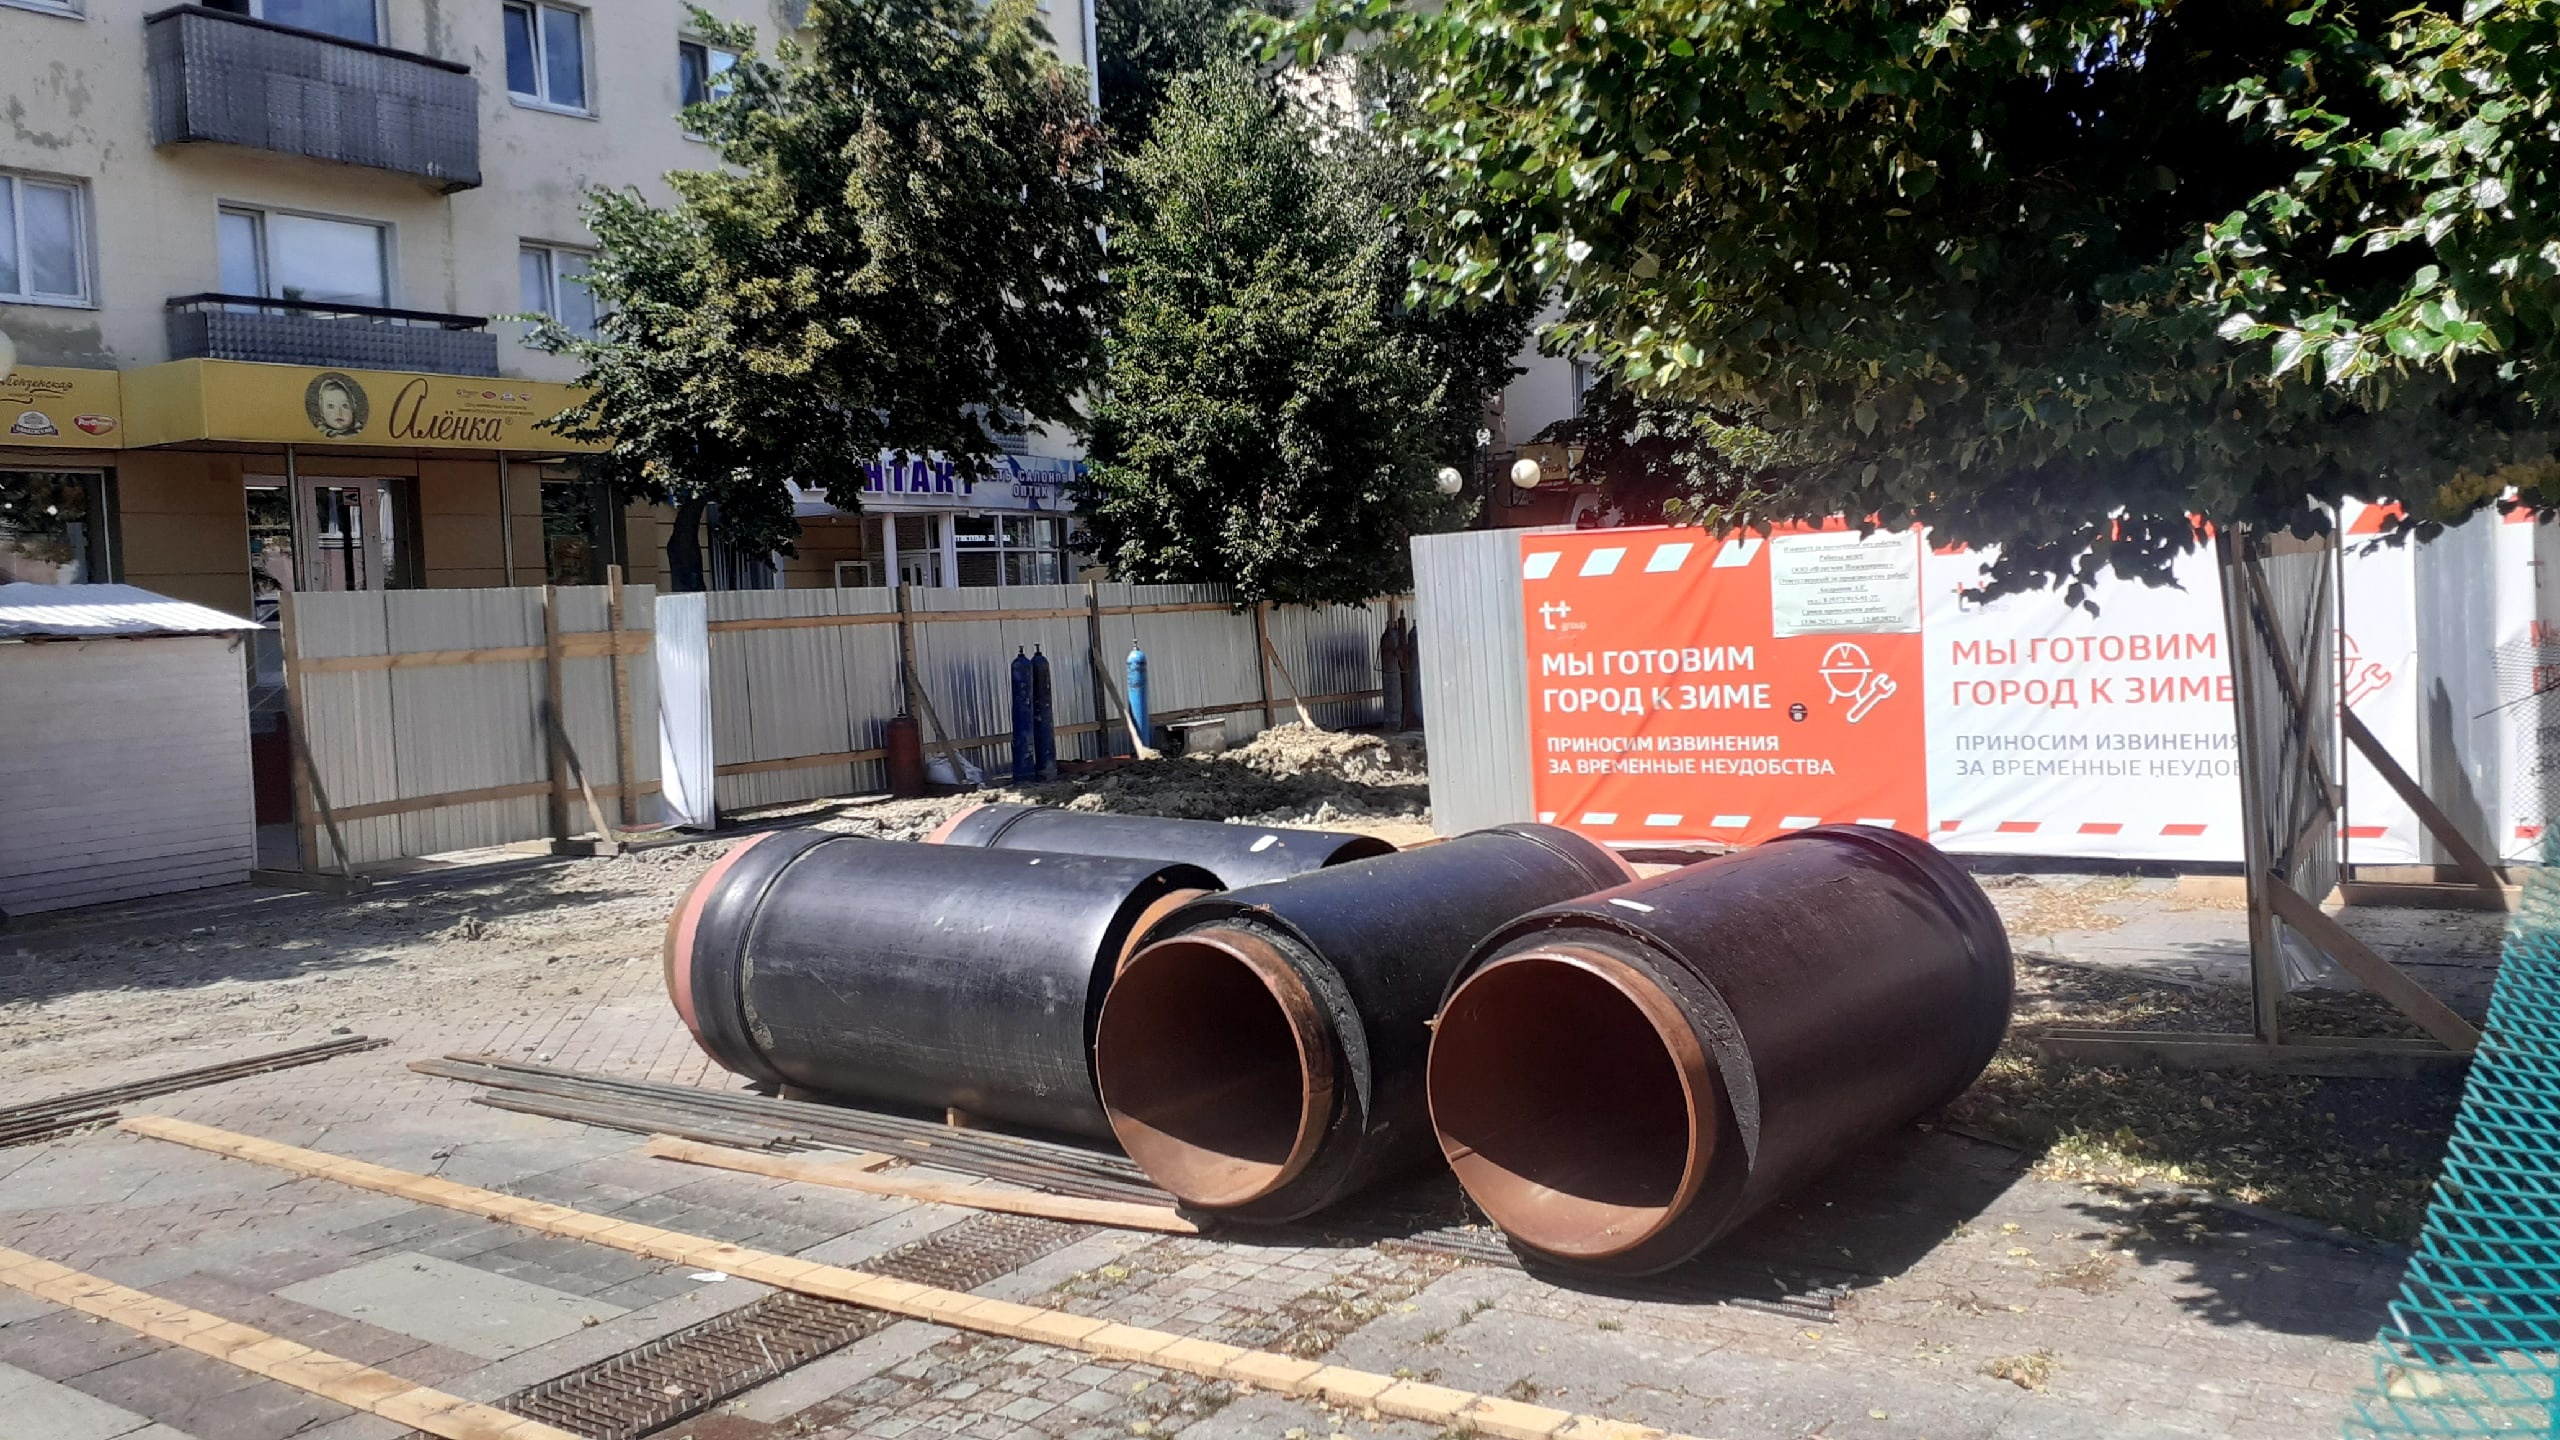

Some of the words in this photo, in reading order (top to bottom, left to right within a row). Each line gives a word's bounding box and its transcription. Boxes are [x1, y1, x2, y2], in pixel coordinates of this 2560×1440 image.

[389, 378, 503, 442] Алёнка
[1012, 485, 1049, 498] ОПТИК
[1561, 621, 1587, 632] group
[1952, 638, 2016, 665] МЫ
[2030, 633, 2217, 663] ГОТОВИМ
[1542, 651, 1595, 677] МЫ
[1602, 646, 1755, 675] ГОТОВИМ
[1543, 687, 1645, 715] ГОРОД
[1652, 687, 1673, 710] К
[1679, 683, 1772, 710] ЗИМЕ
[1952, 679, 2079, 709] ГОРОД
[2091, 678, 2114, 704] К
[2125, 675, 2236, 703] ЗИМЕ
[1547, 736, 1653, 753] ПРИНОСИМ
[1657, 735, 1780, 751] ИЗВИНЕНИЯ
[1955, 734, 2088, 751] ПРИНОСИМ
[1548, 758, 1573, 774] ЗА
[1577, 758, 1697, 775] ВРЕМЕННЫЕ
[1701, 758, 1836, 776] НЕУДОБСТВА
[1955, 759, 1985, 776] ЗА
[1992, 759, 2142, 776] ВРЕМЕННЫЕ
